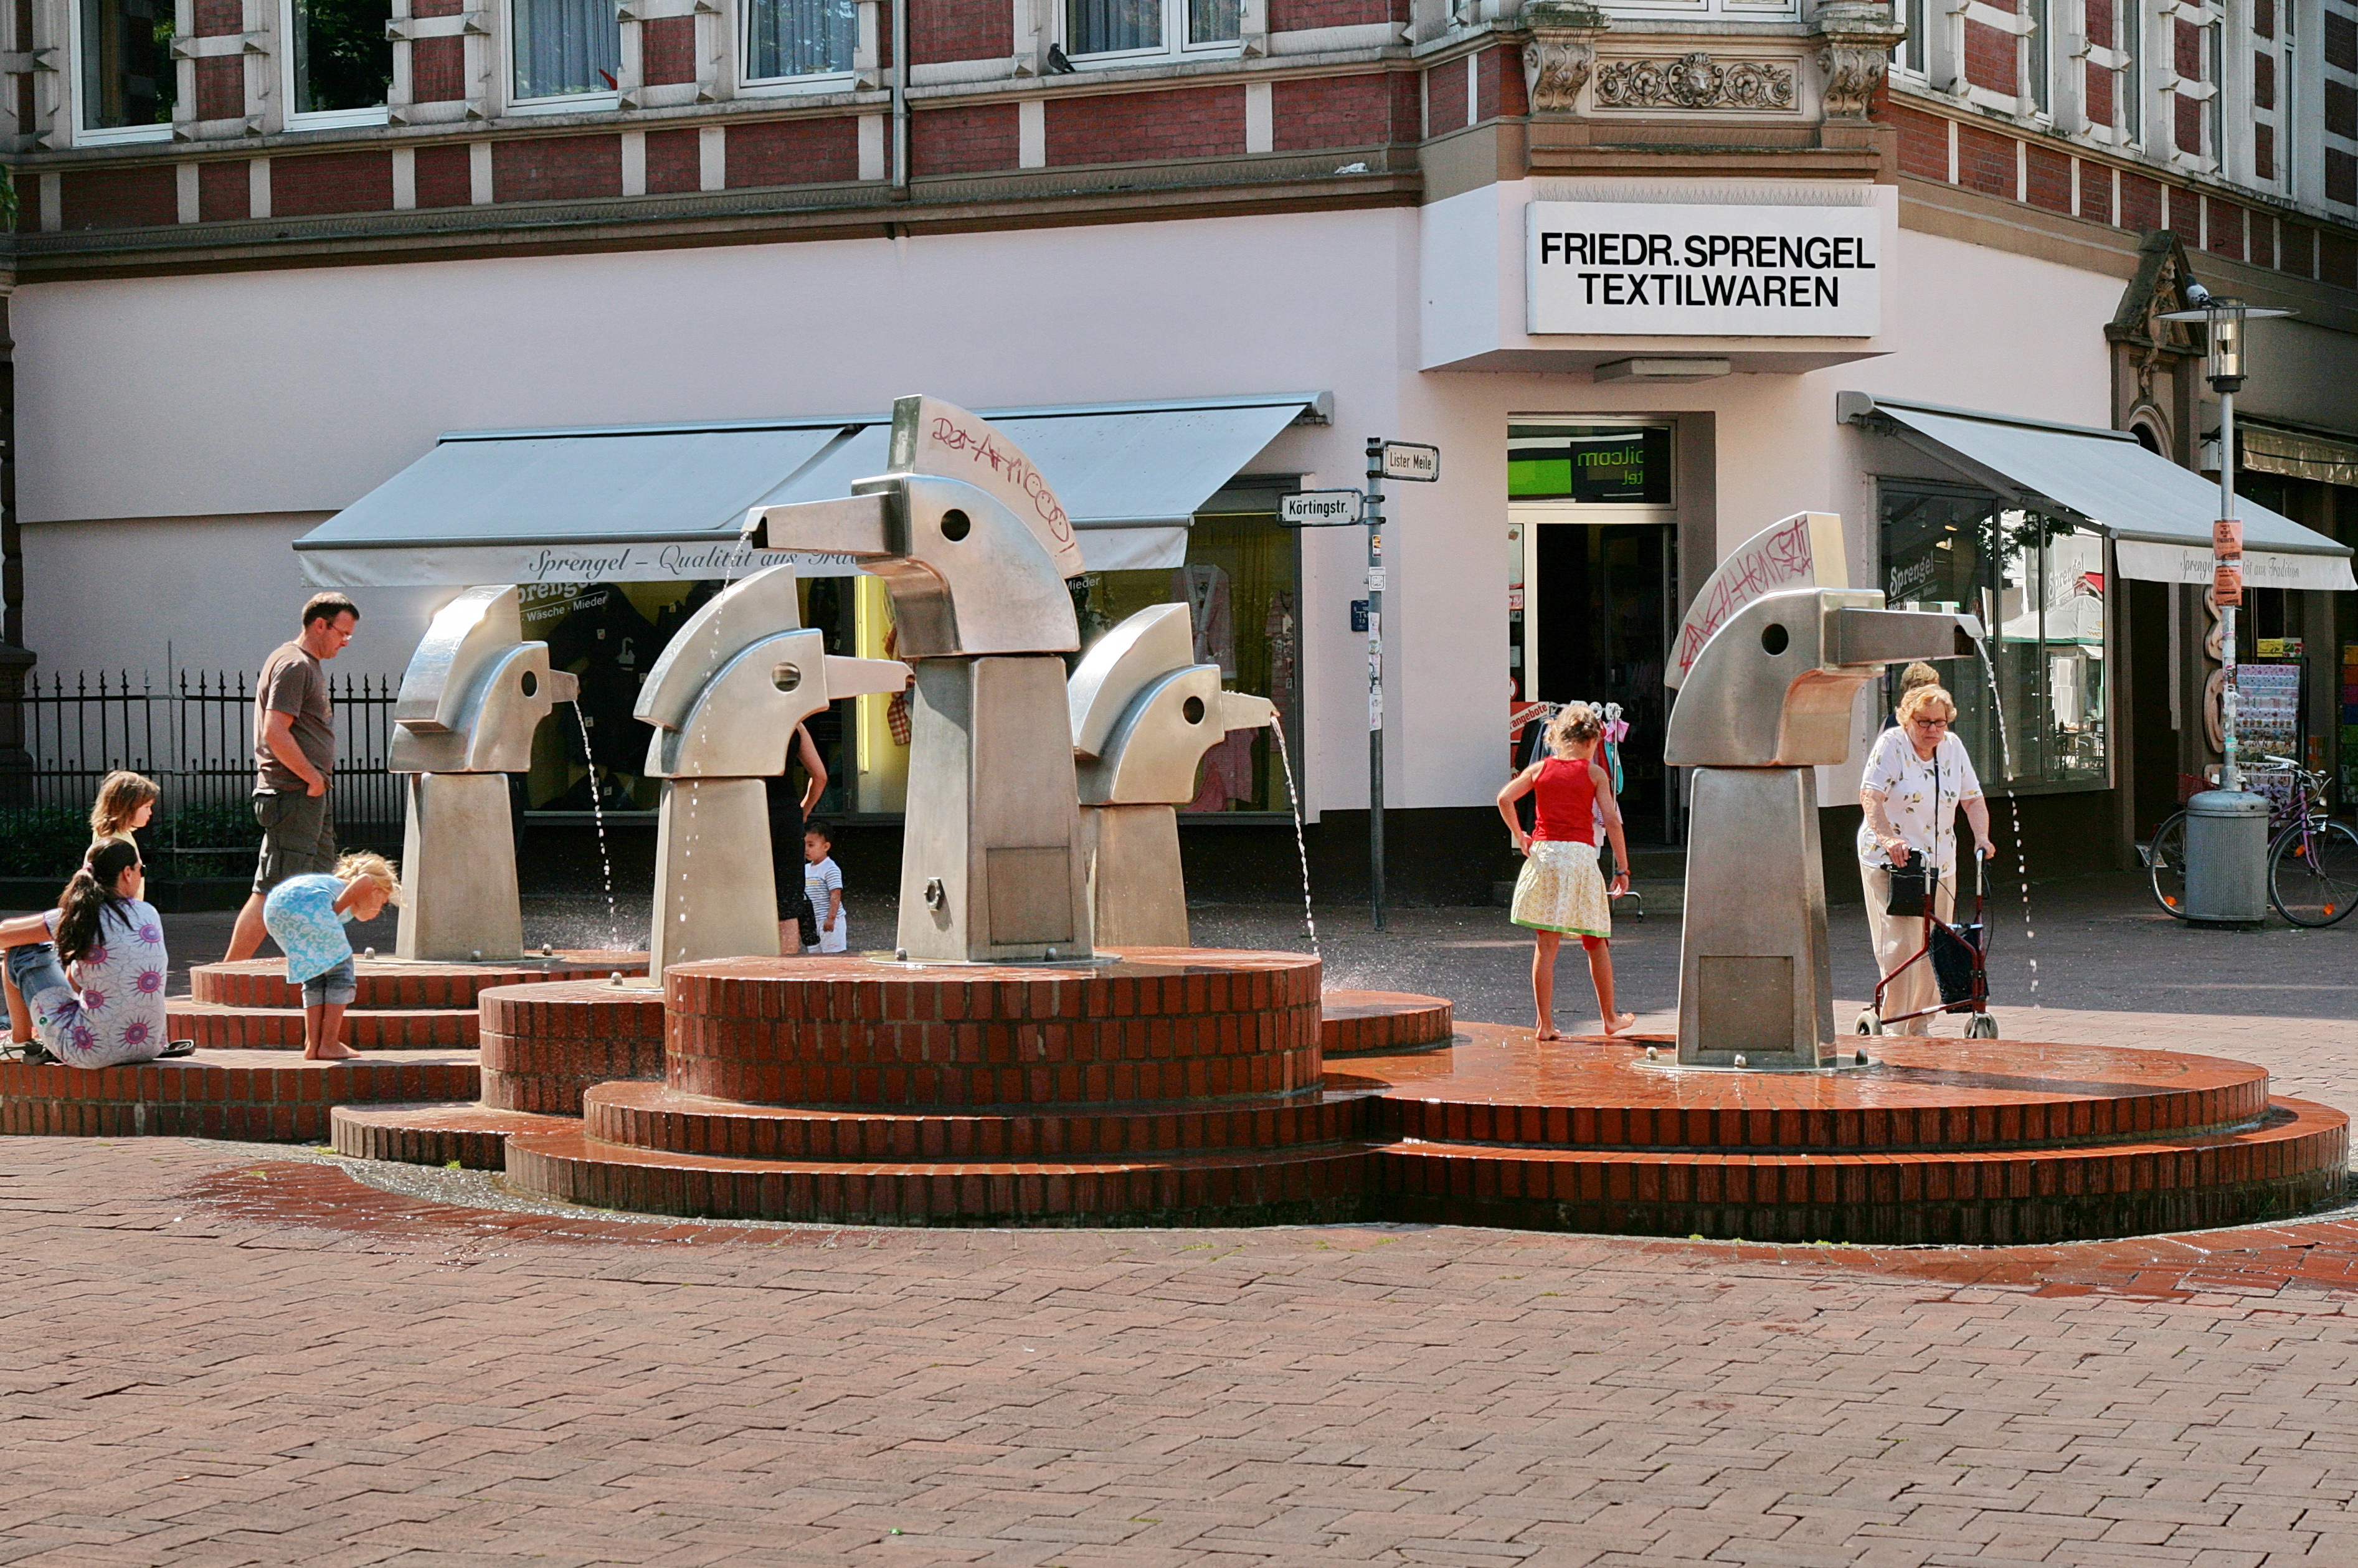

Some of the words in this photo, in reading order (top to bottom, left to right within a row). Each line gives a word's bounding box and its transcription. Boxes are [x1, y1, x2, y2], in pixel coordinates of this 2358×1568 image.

[1578, 273, 1839, 308] TEXTILWAREN
[1390, 452, 1410, 468] Lister
[1413, 455, 1432, 470] Meile
[1289, 499, 1348, 517] Körtingstr.
[529, 549, 631, 580] Sprengel
[1890, 549, 1934, 597] Sprengel
[2180, 550, 2214, 581] Sprengel
[2268, 557, 2299, 578] Tradition
[527, 607, 566, 621] Wäsche
[573, 595, 607, 612] Mieder
[1510, 704, 1548, 729] angebote
